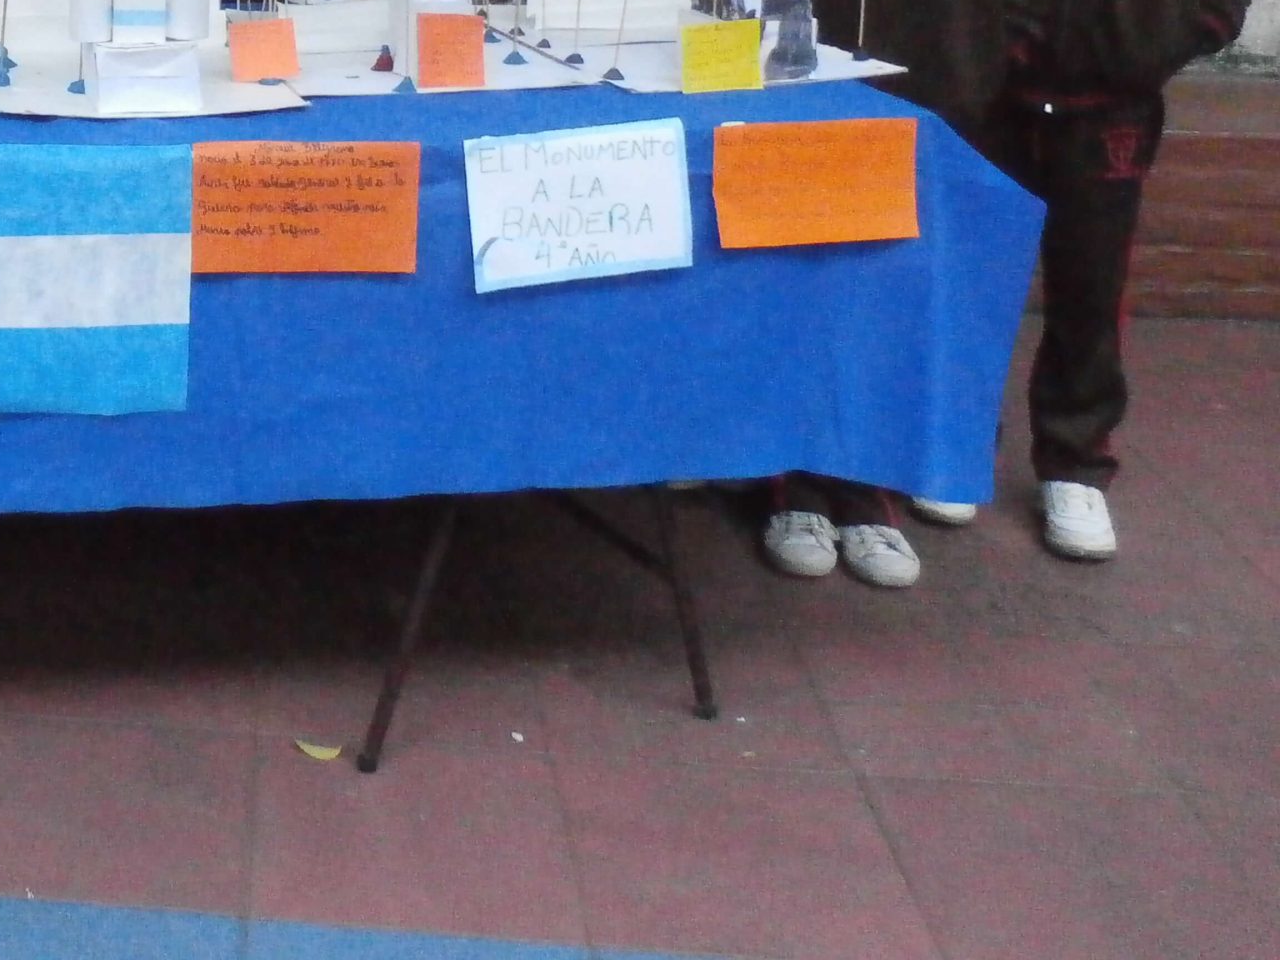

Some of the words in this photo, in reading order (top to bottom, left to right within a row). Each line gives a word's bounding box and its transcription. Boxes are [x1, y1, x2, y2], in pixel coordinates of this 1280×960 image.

[478, 146, 513, 174] EL
[531, 178, 550, 203] A
[568, 175, 605, 200] LA
[501, 202, 655, 241] BANDERA
[568, 242, 617, 268] AÑO
